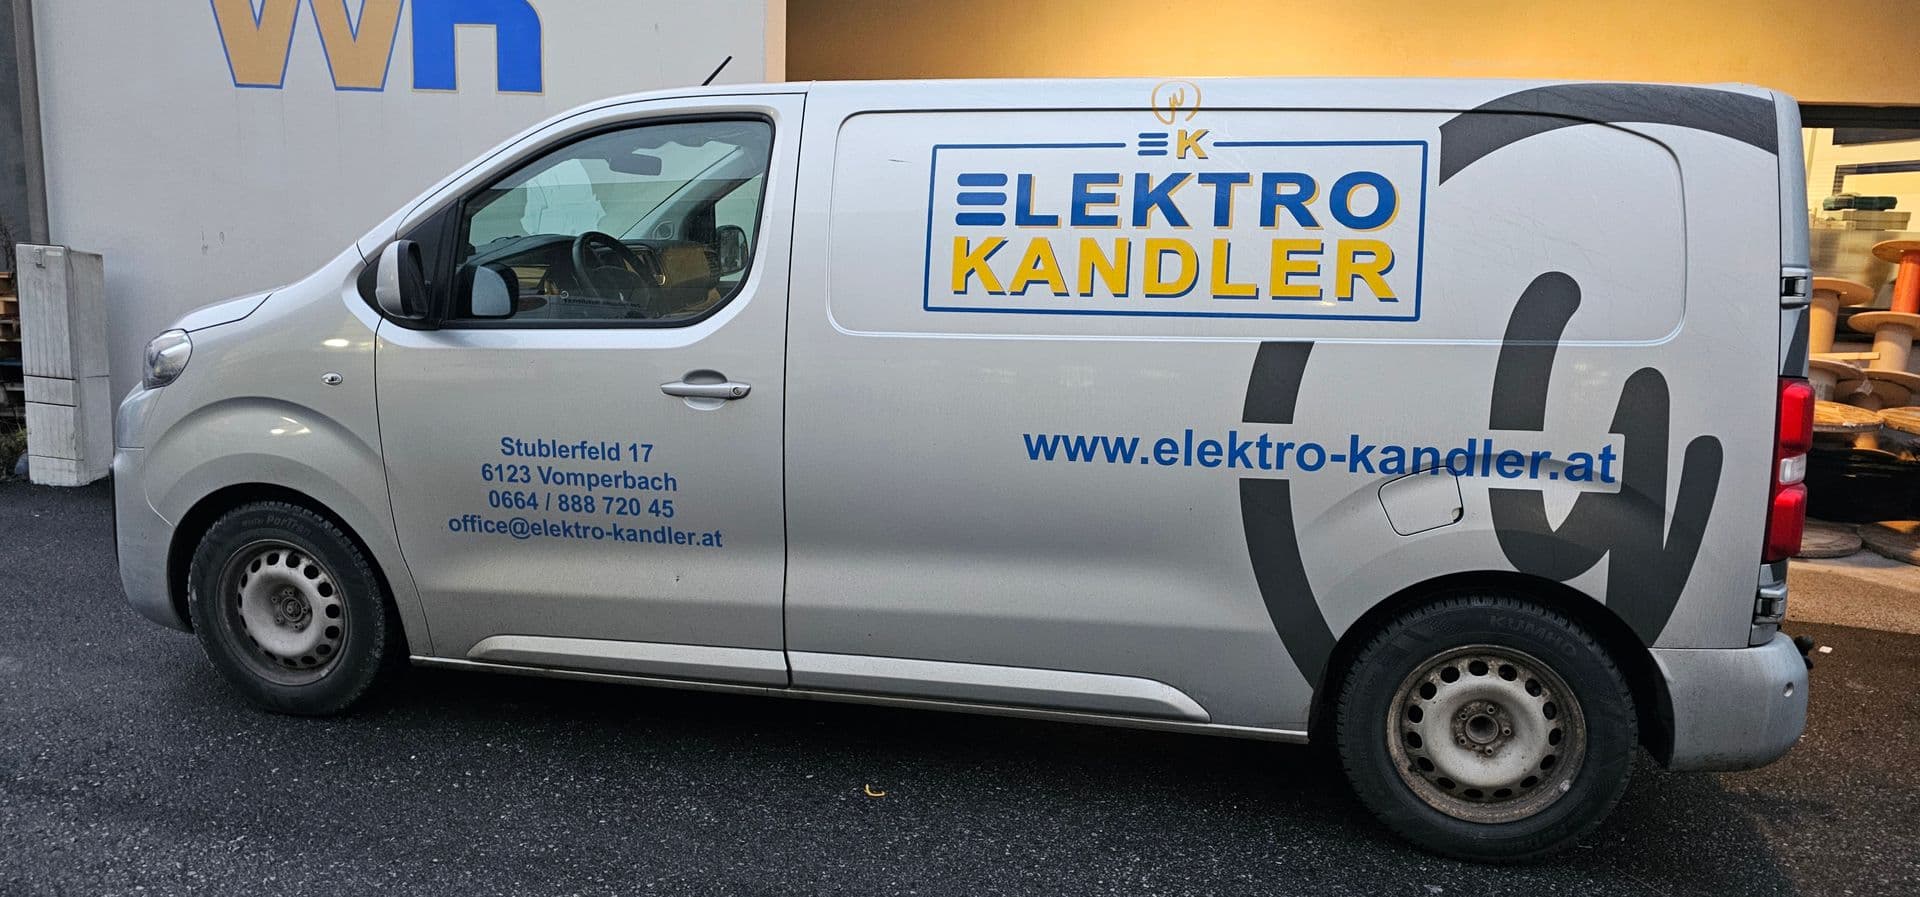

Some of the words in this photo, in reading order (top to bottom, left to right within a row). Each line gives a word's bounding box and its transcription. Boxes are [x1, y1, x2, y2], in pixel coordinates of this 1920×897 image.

[955, 171, 1400, 230] ELEKTRO
[951, 236, 1399, 302] KANDLER
[500, 437, 620, 462] Stublerfeld
[628, 443, 653, 462] 17
[1023, 429, 1617, 484] www.elektro-kandler.at
[481, 464, 531, 484] 6123
[537, 466, 677, 492] Vomperbach
[488, 490, 538, 511] 0664
[558, 495, 596, 514] 888
[602, 497, 641, 516] 720
[648, 499, 674, 518] 45
[448, 514, 723, 548] office@elektro-kandler.at
